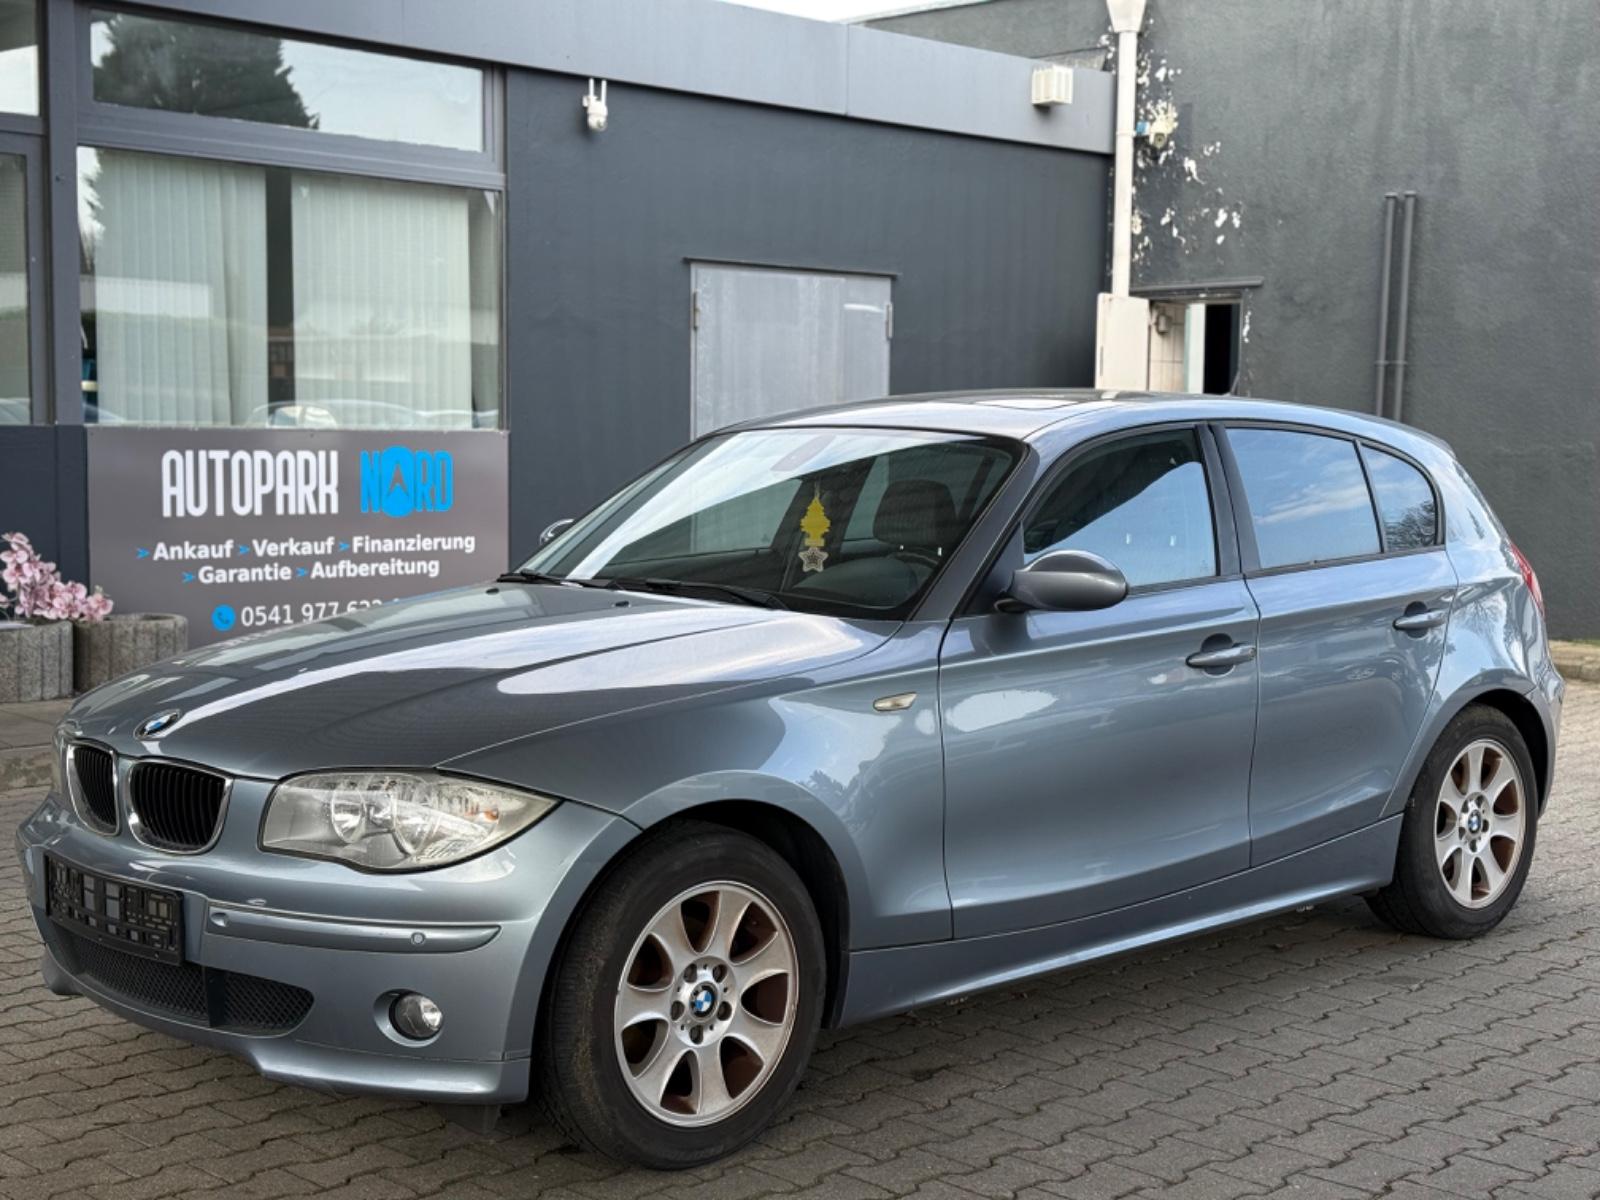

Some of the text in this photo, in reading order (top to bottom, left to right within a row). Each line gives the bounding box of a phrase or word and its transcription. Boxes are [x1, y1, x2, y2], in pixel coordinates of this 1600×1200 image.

[161, 444, 454, 518] AUTOPARK NORD
[153, 534, 476, 561] Ankauf Verkauf Finanzierung
[198, 558, 440, 584] Garantie Aufbereitung
[241, 604, 294, 627] 0541
